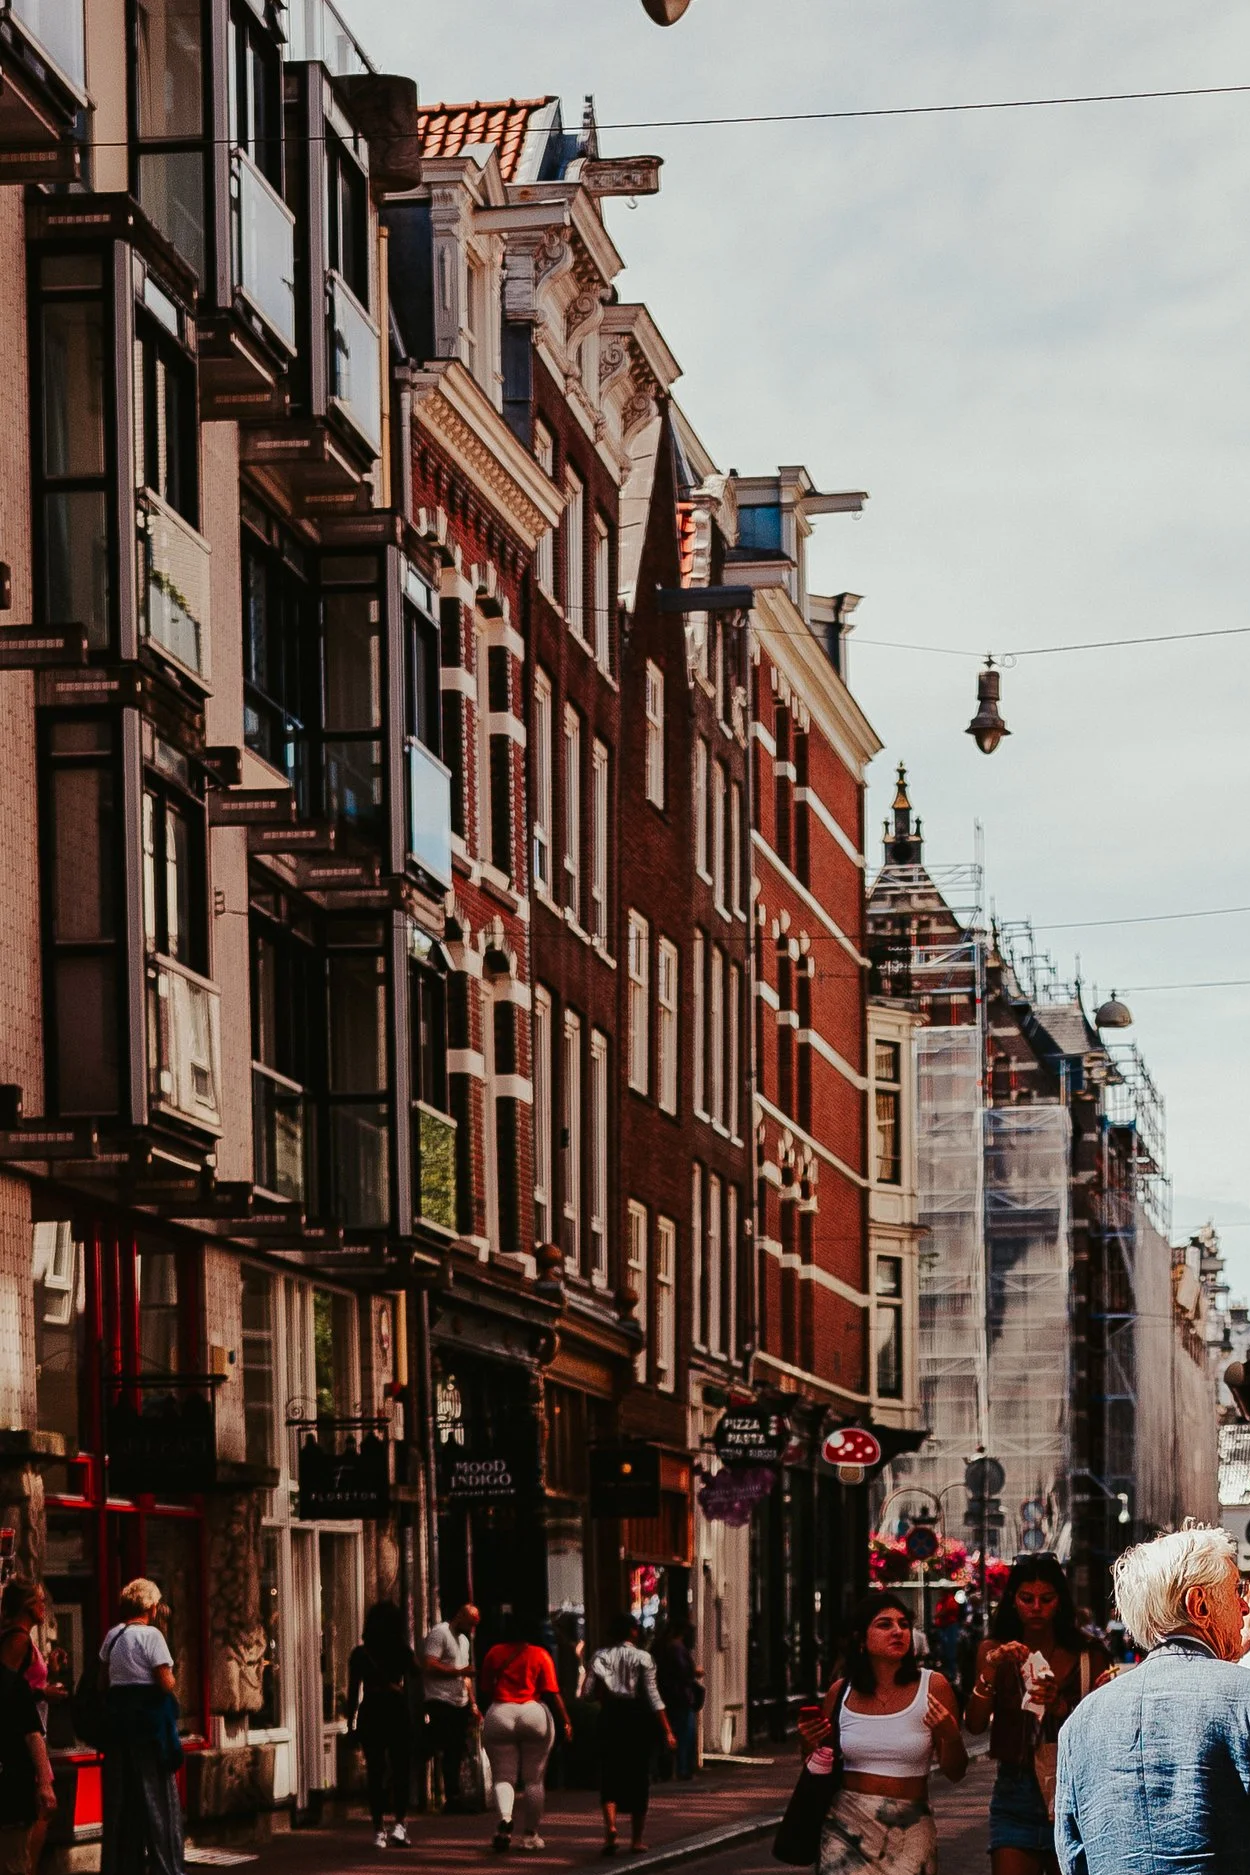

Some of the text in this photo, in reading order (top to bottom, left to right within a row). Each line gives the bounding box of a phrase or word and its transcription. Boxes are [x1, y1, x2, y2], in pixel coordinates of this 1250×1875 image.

[723, 1418, 761, 1430] PIZZA
[726, 1432, 767, 1444] PASTA
[455, 1459, 507, 1473] MOOD
[450, 1472, 512, 1488] INDIGO
